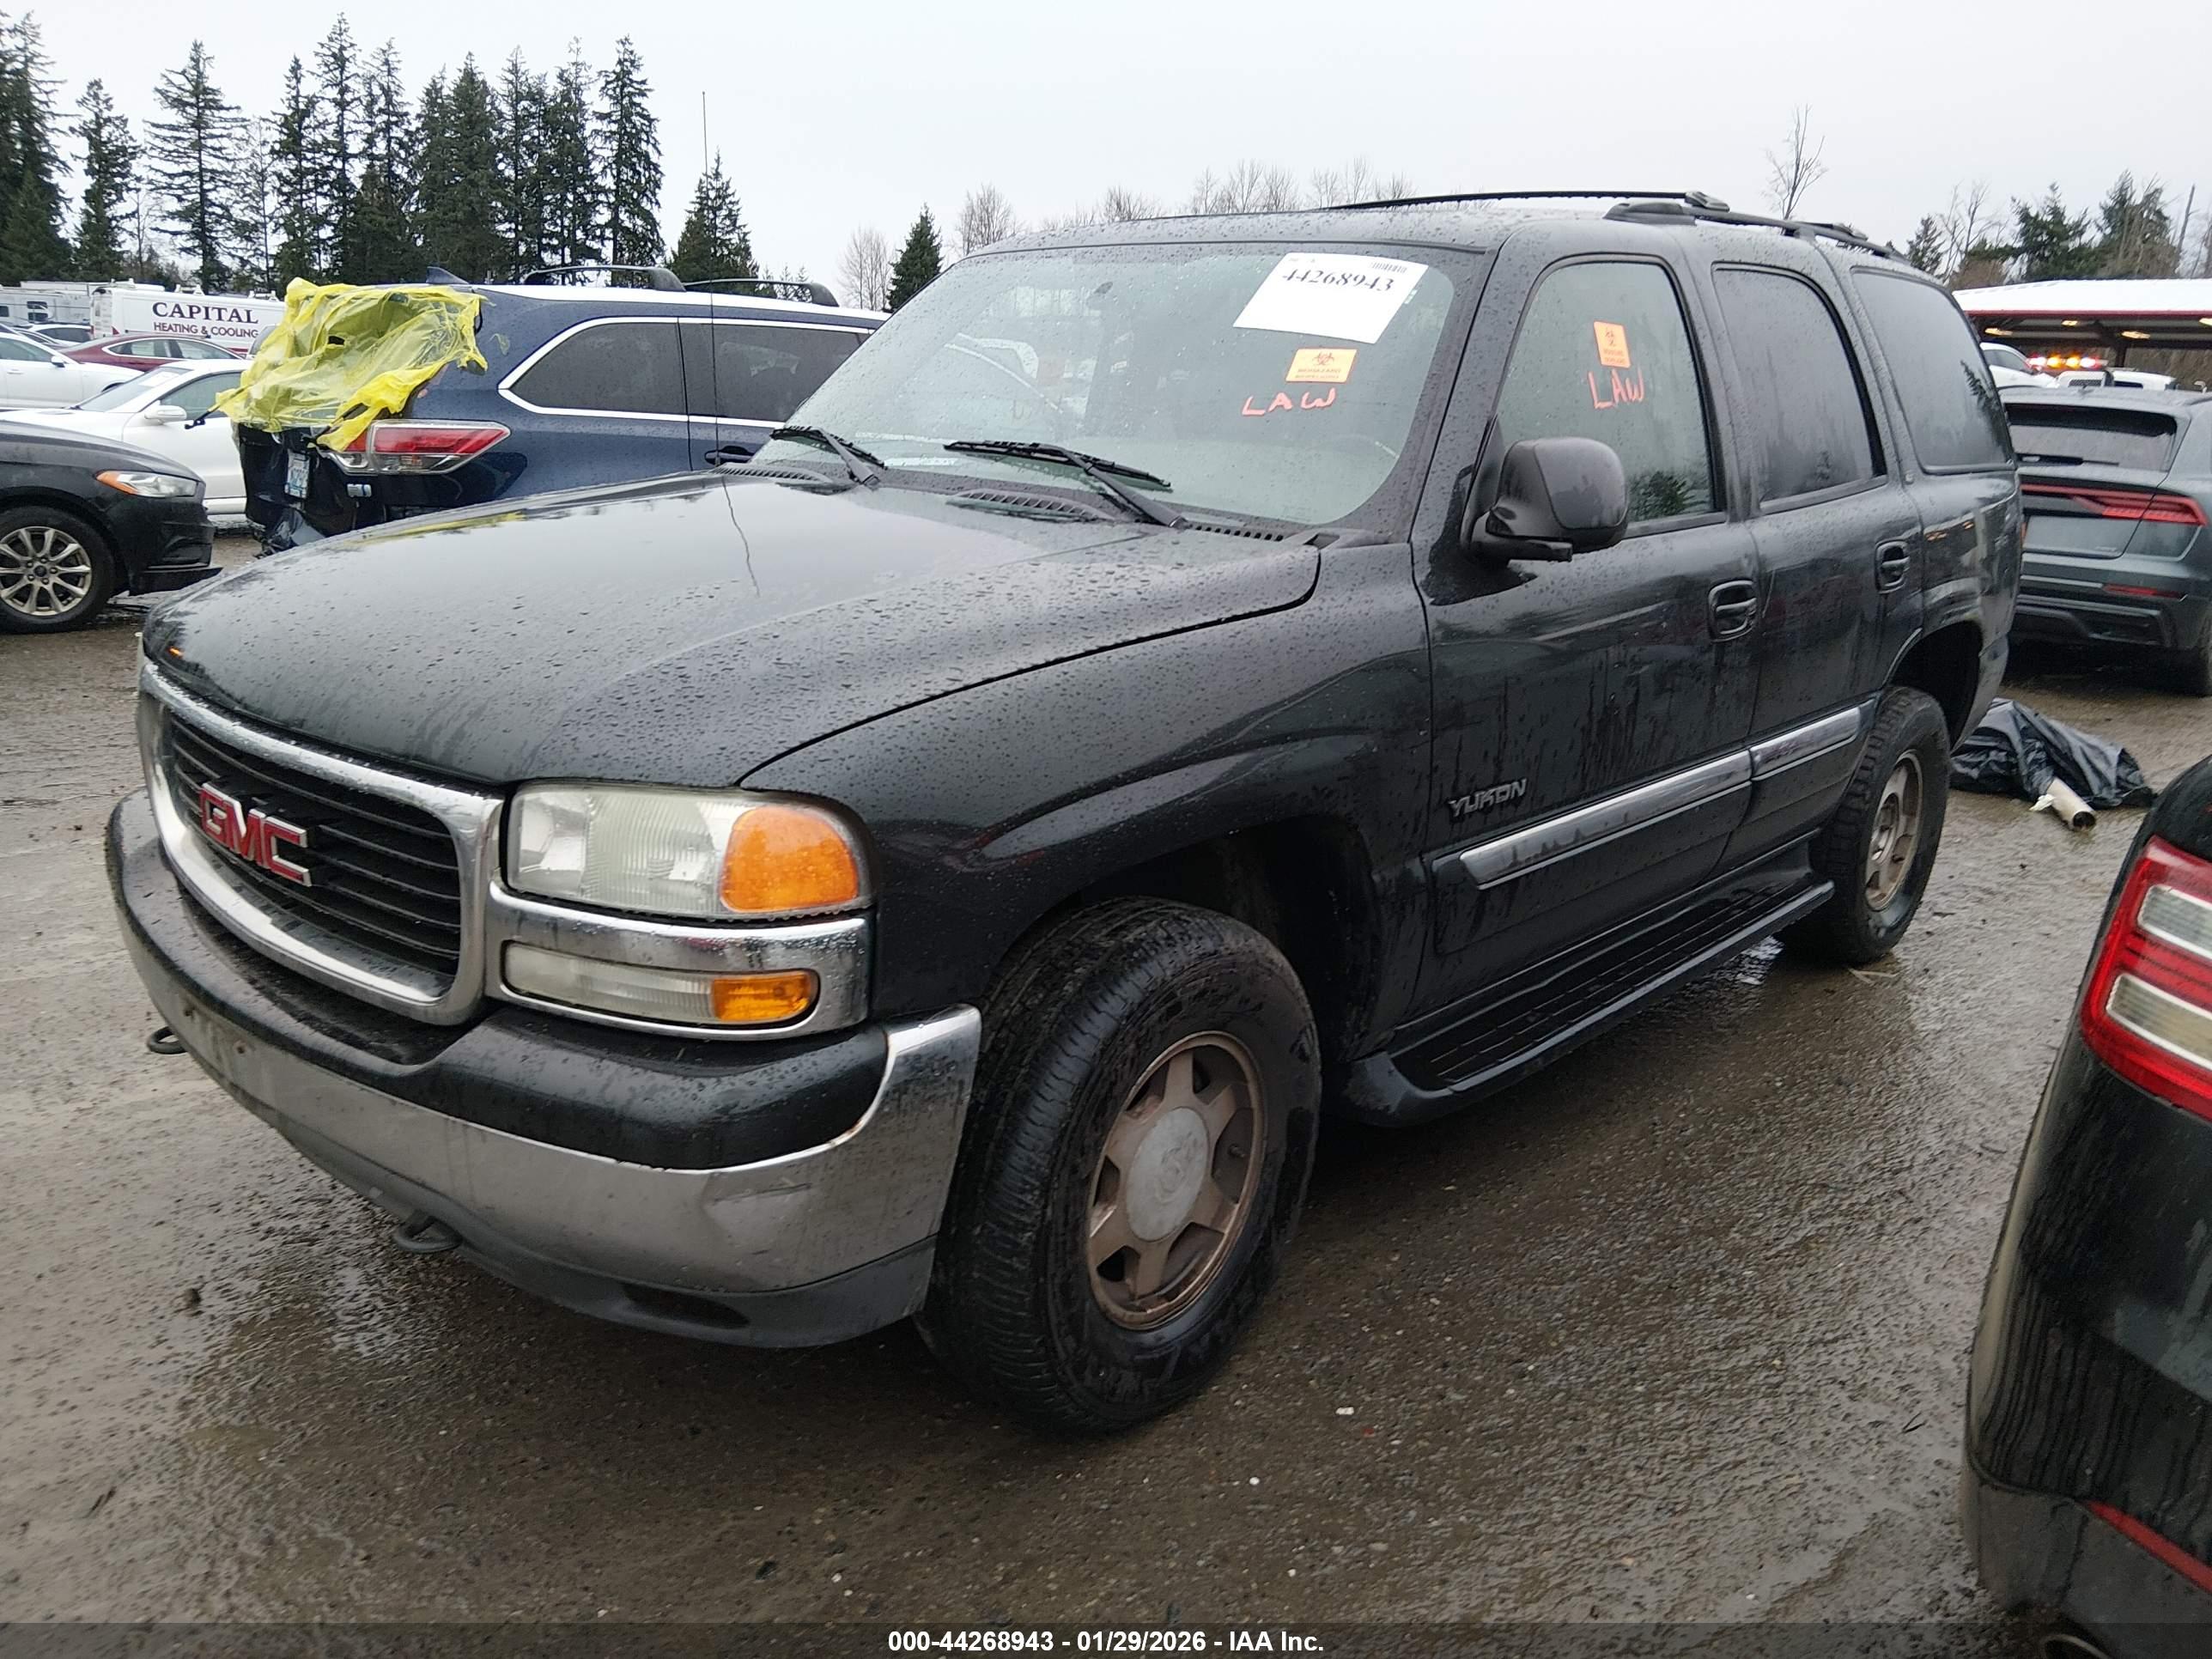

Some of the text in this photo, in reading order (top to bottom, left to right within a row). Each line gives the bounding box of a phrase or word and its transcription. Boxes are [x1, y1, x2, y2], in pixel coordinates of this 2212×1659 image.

[1282, 268, 1395, 292] 44268943
[152, 301, 258, 324] CAPITAL
[154, 322, 258, 338] HEATING & COOLING
[1242, 387, 1336, 416] LAW
[1588, 368, 1644, 409] LAW
[1448, 778, 1527, 817] YUKON
[199, 782, 313, 887] GMC
